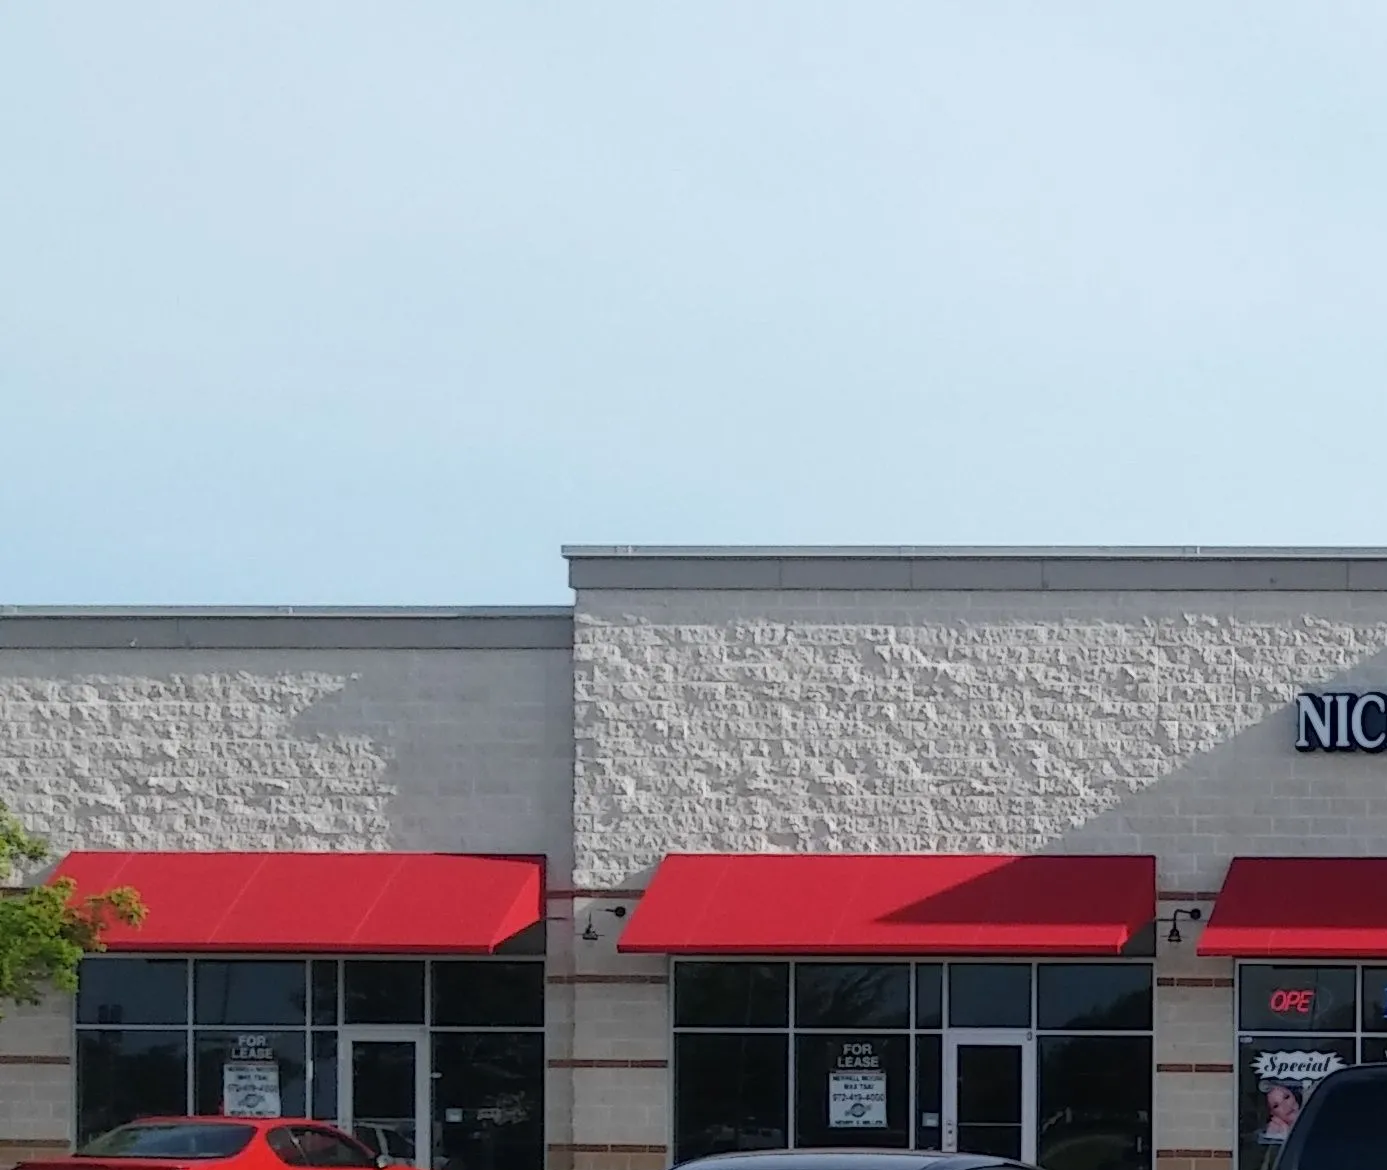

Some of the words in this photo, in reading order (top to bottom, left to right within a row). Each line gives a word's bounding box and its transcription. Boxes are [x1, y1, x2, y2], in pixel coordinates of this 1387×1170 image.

[238, 1034, 266, 1047] FOR
[231, 1047, 274, 1059] LEASE
[842, 1043, 873, 1055] FOR
[836, 1055, 880, 1068] LEASE
[1263, 1056, 1331, 1076] Special
